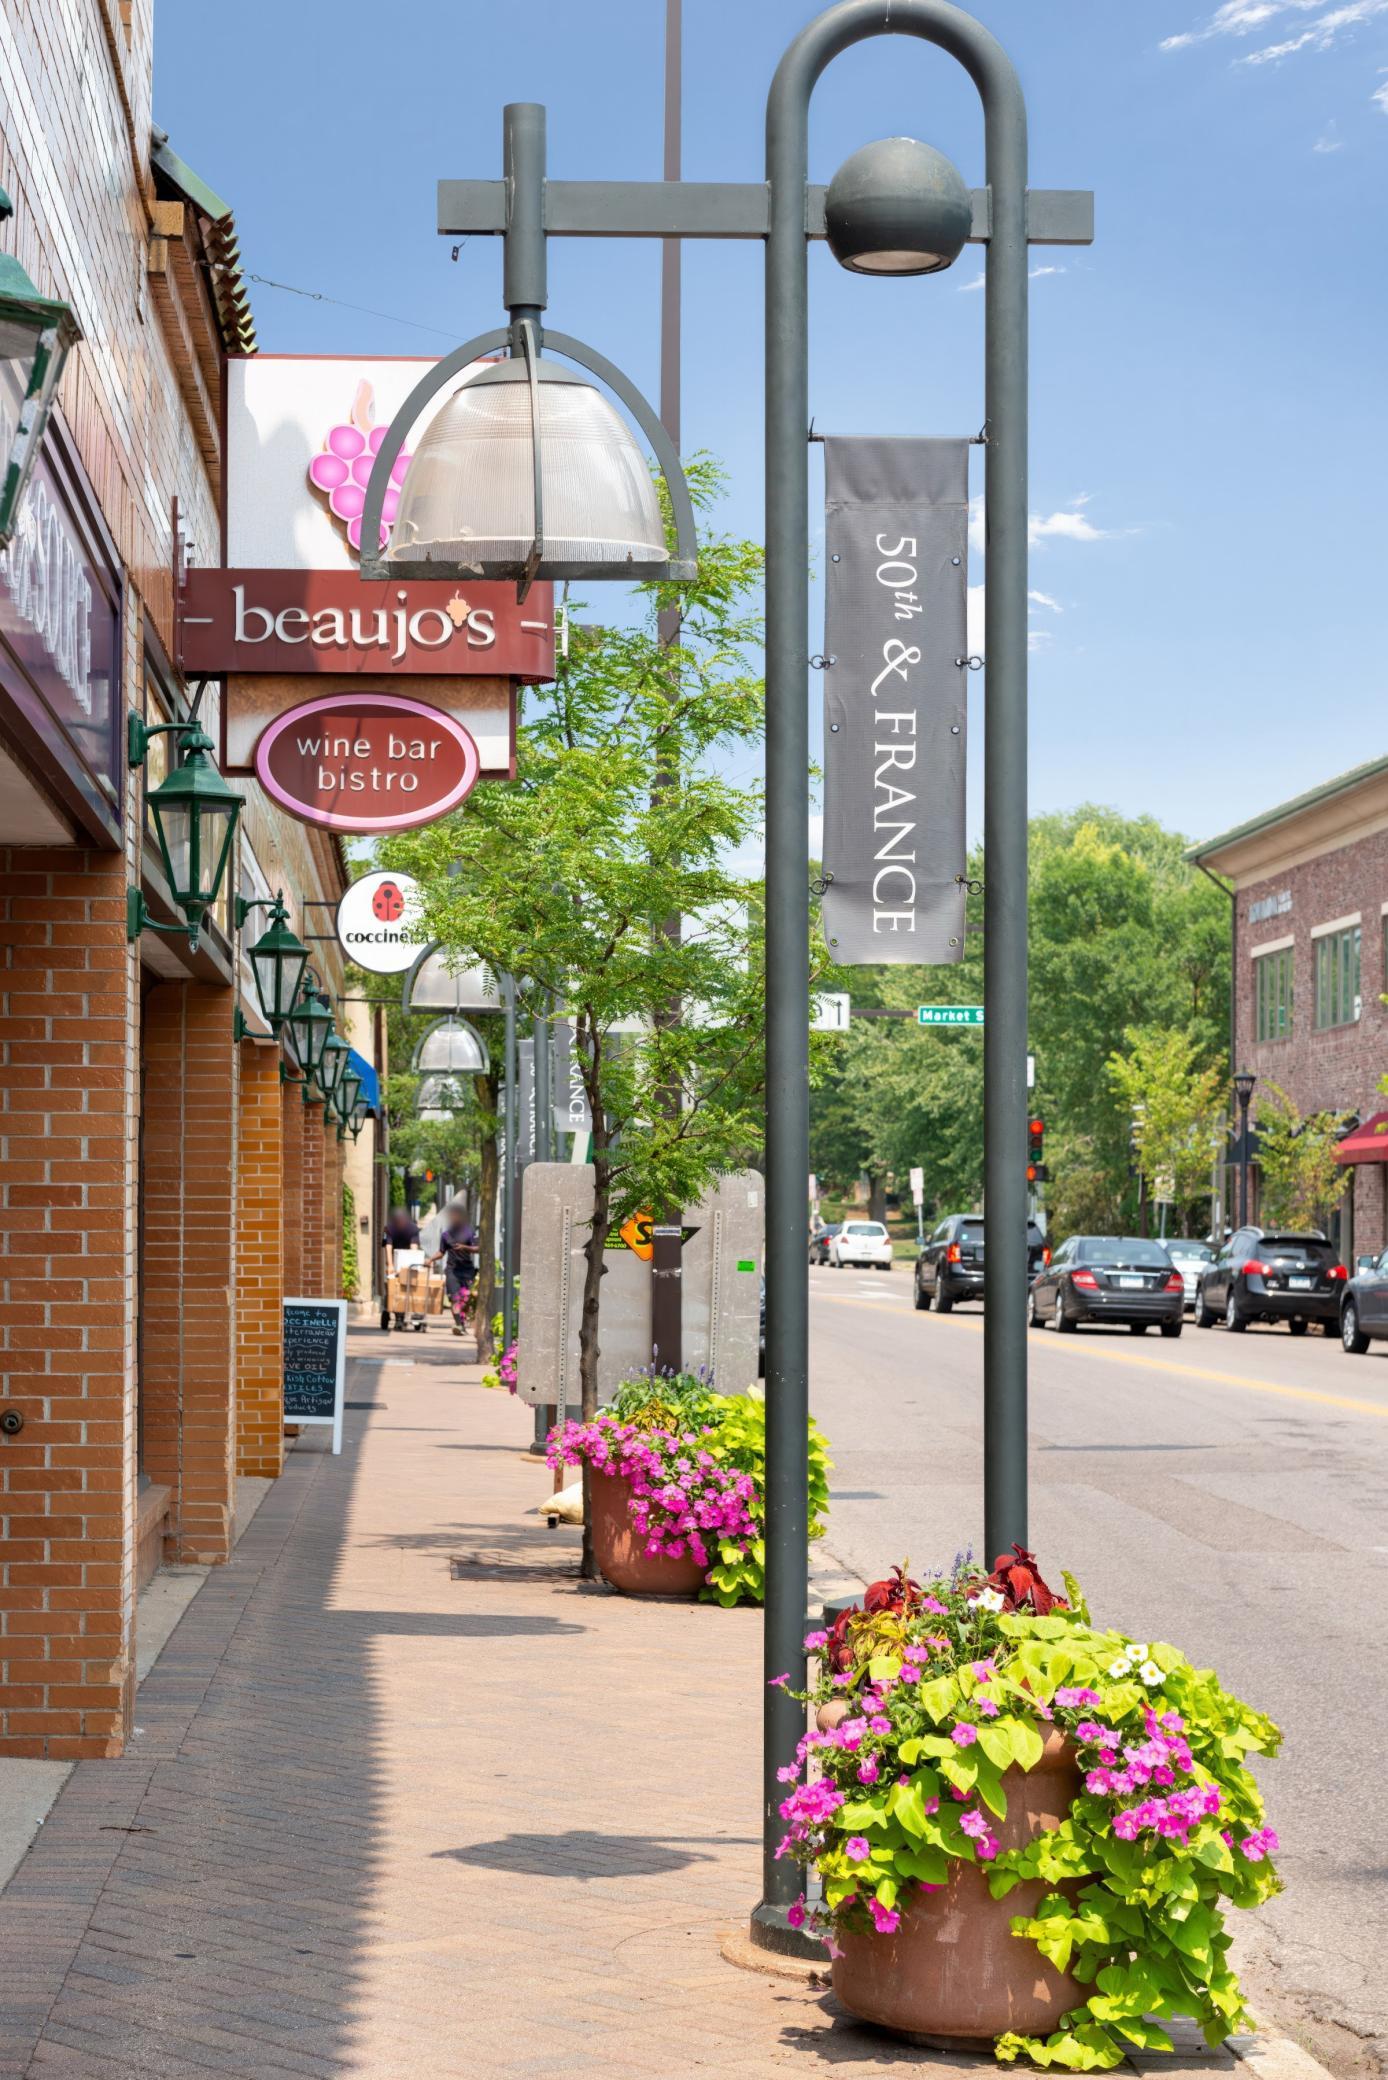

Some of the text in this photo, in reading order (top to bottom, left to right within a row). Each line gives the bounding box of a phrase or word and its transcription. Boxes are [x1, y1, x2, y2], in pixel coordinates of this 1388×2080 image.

[297, 732, 442, 760] wine bar
[871, 533, 923, 934] 50th & FRANCE
[318, 766, 419, 792] bistro
[922, 1010, 984, 1022] Market S
